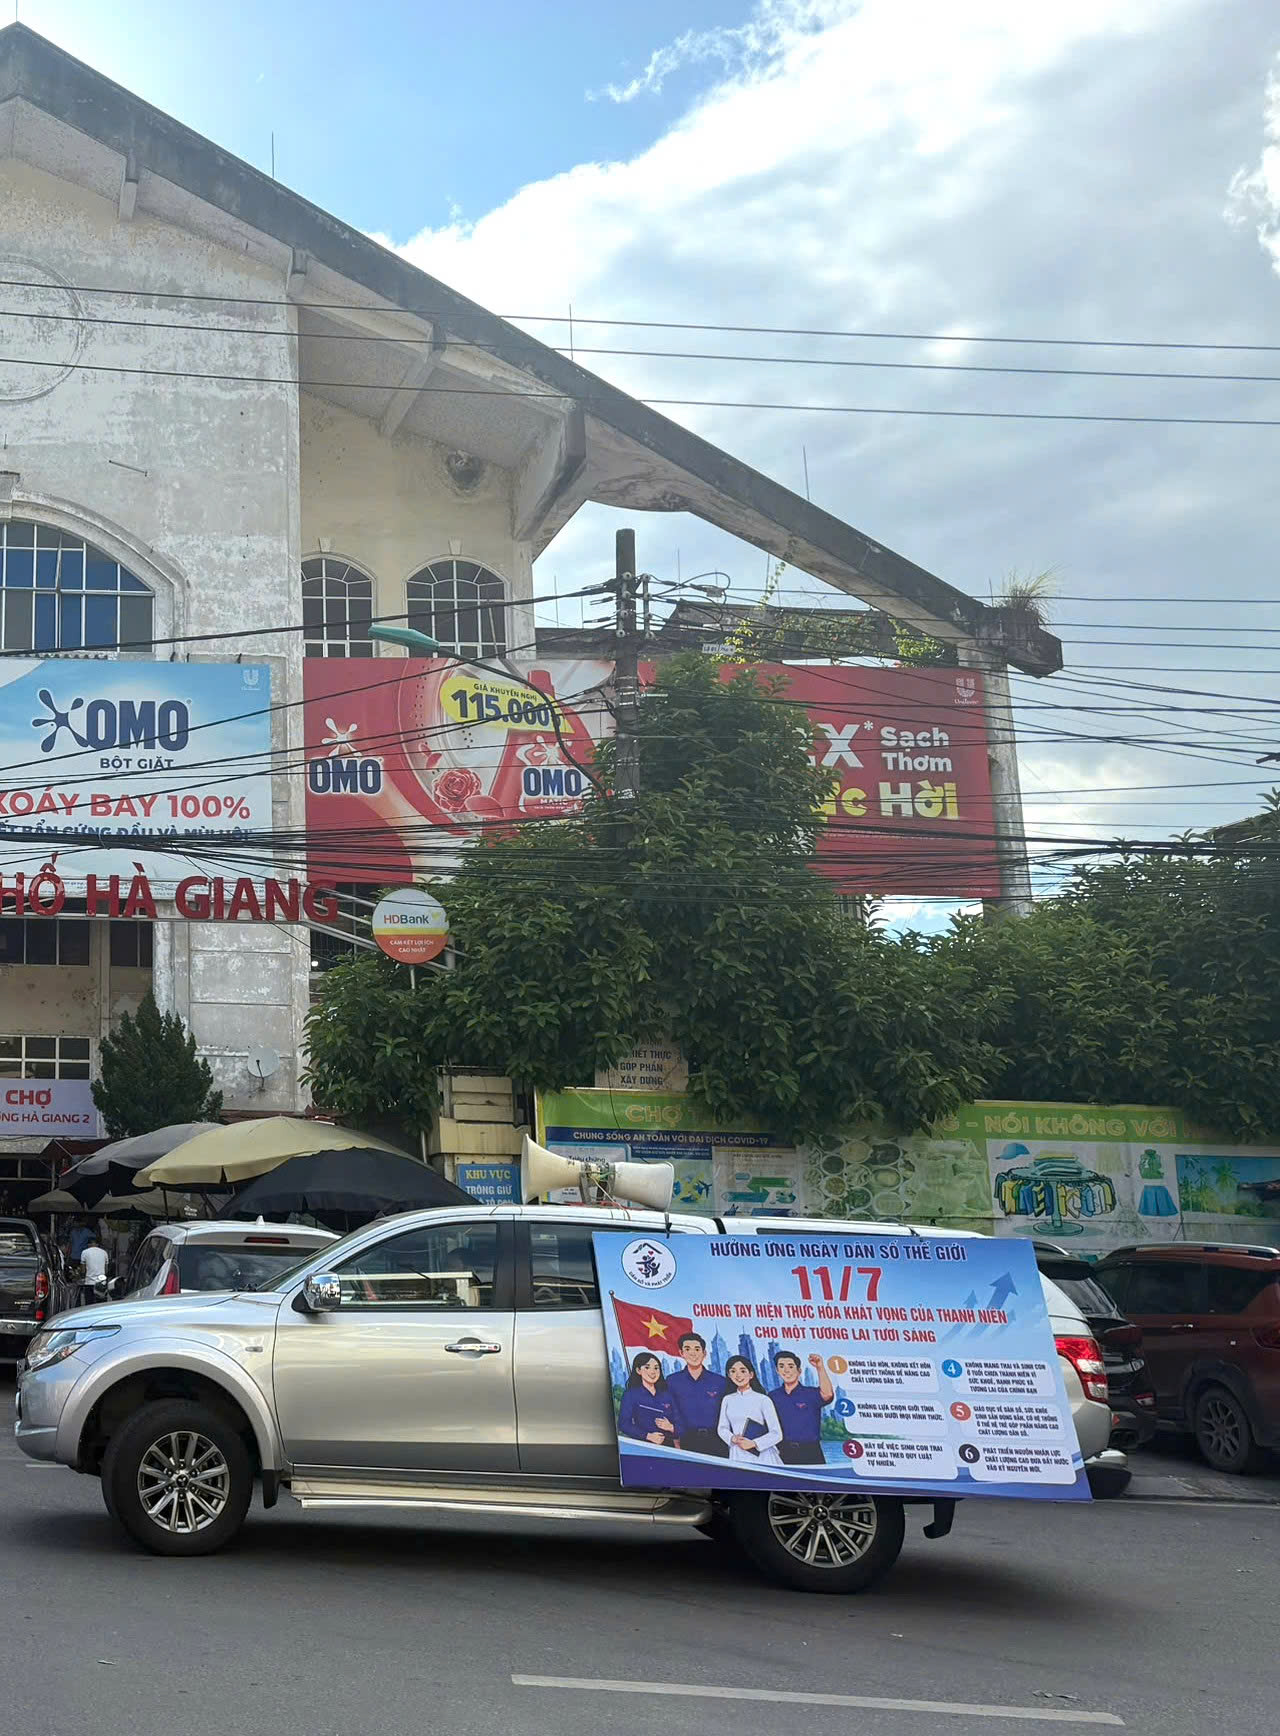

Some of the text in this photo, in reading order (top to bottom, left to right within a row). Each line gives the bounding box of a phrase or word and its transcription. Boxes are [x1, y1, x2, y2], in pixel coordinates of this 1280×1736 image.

[451, 690, 560, 728] 115.000
[87, 700, 188, 751] OMO
[881, 727, 949, 751] Sạch
[100, 756, 132, 771] BỘT
[882, 752, 952, 772] Thơm
[310, 760, 380, 794] OMO
[524, 768, 581, 796] OMO
[91, 794, 158, 817] BAY
[165, 795, 250, 819] 100%
[879, 780, 959, 820] Hời
[87, 862, 157, 919] HÀ
[176, 875, 340, 922] GIANG
[384, 915, 429, 924] HDBank
[6, 1088, 52, 1108] CHỢ
[22, 1111, 38, 1122] HÀ
[42, 1114, 79, 1123] GIANG
[83, 1115, 89, 1123] 2
[626, 1104, 682, 1126] CHỢ
[984, 1112, 1029, 1133] NÓI
[1036, 1113, 1126, 1135] KHÔNG
[1131, 1118, 1175, 1137] VỚI
[573, 1132, 604, 1140] CHUNG
[607, 1130, 630, 1141] SỐNG
[634, 1133, 646, 1141] AN
[646, 1132, 669, 1142] TOÀN
[672, 1133, 687, 1143] VỚI
[728, 1137, 768, 1145] COVID-19
[465, 1169, 511, 1182] KHU VỰC
[766, 1240, 795, 1257] ỨNG
[800, 1241, 839, 1258] NGÀY
[845, 1242, 874, 1259] DÂN
[881, 1240, 899, 1259] SỐ
[904, 1241, 931, 1260] THẾ
[936, 1243, 967, 1260] GIỚI
[792, 1266, 882, 1302] 11/7
[693, 1302, 1008, 1324] CHUNG TAY HIỆN THỰC HÓA KHÁT VỌNG CỦA THANH NIÊN
[755, 1325, 936, 1343] CHO MỘT TƯƠNG LAI TƯƠI SÁNG
[834, 1359, 840, 1371] 1
[947, 1363, 956, 1375] 4
[840, 1402, 849, 1413] 2
[956, 1405, 965, 1417] 5
[849, 1443, 857, 1455] 3
[965, 1448, 974, 1459] 6
